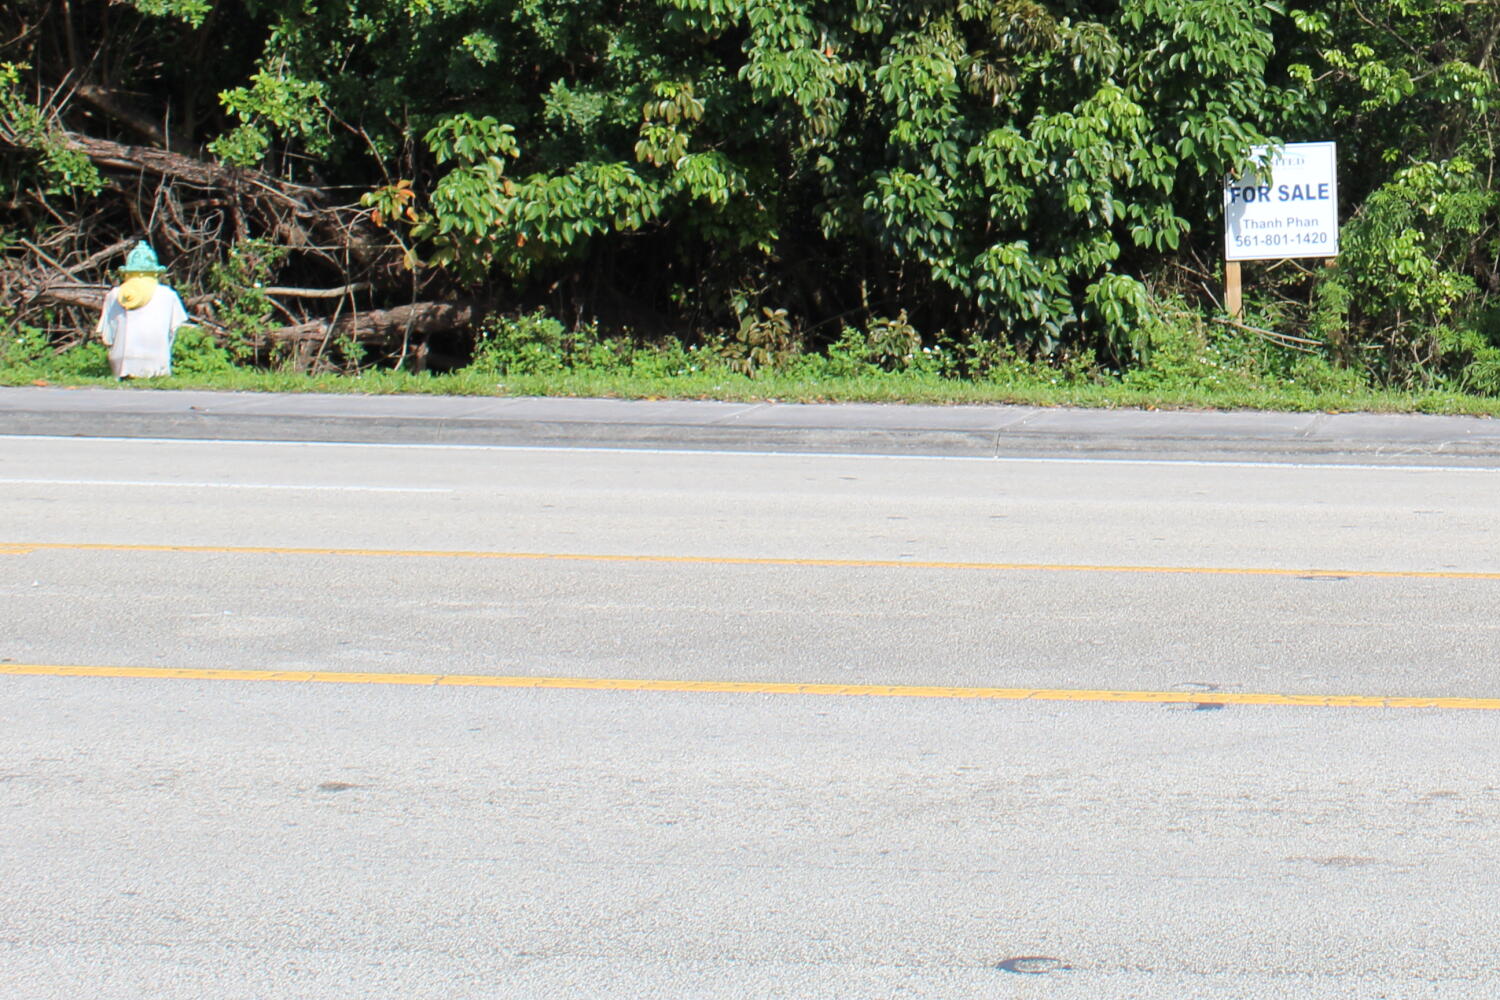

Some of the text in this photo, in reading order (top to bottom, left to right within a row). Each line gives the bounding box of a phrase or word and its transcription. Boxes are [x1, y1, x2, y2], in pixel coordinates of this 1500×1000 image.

[1230, 183, 1330, 203] FOR SALE
[1243, 217, 1319, 230] Thanh Phan
[1235, 232, 1328, 248] 561-801-1420
